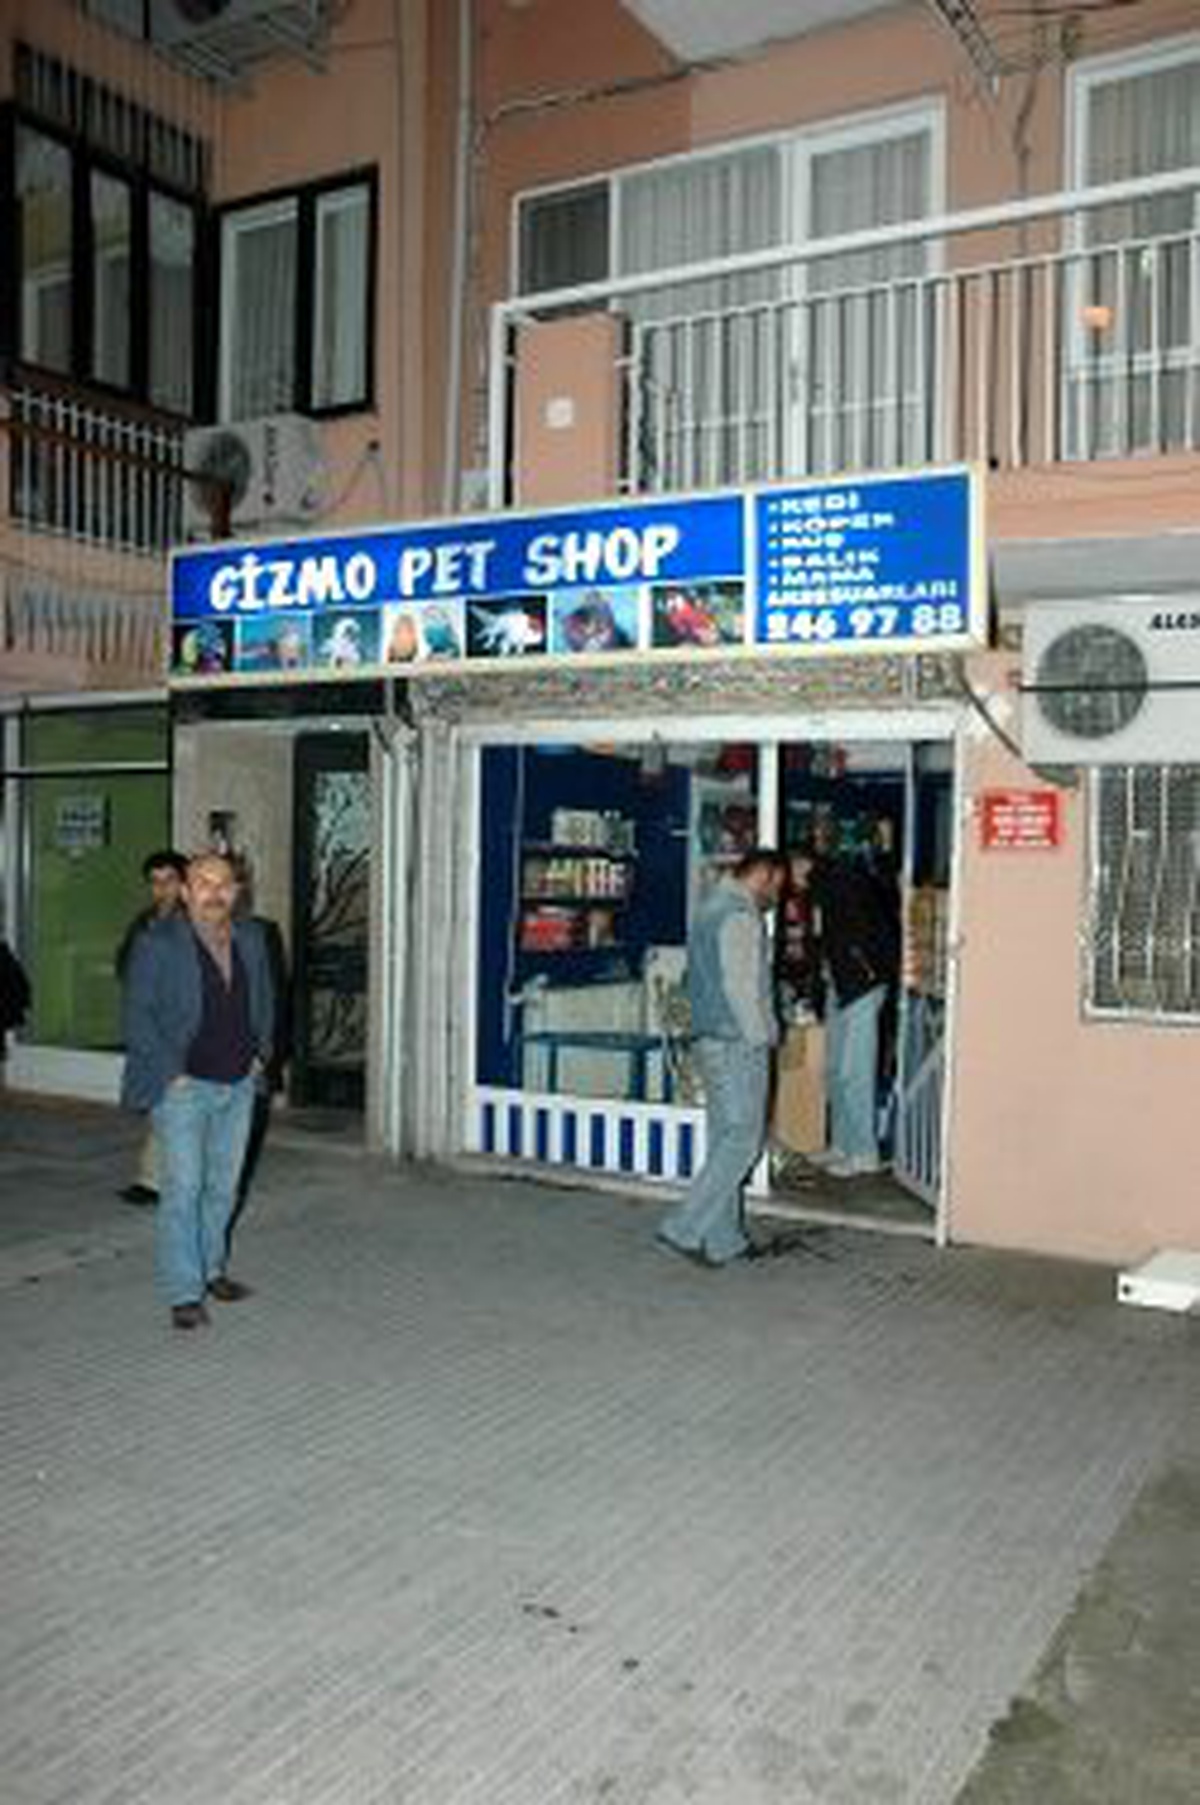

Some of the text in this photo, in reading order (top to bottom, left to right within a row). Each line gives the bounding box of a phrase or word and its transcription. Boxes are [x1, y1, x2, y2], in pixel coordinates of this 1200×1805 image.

[401, 541, 496, 595] PET
[525, 525, 680, 585] SHOP
[850, 606, 899, 637] 97
[912, 603, 962, 634] 88
